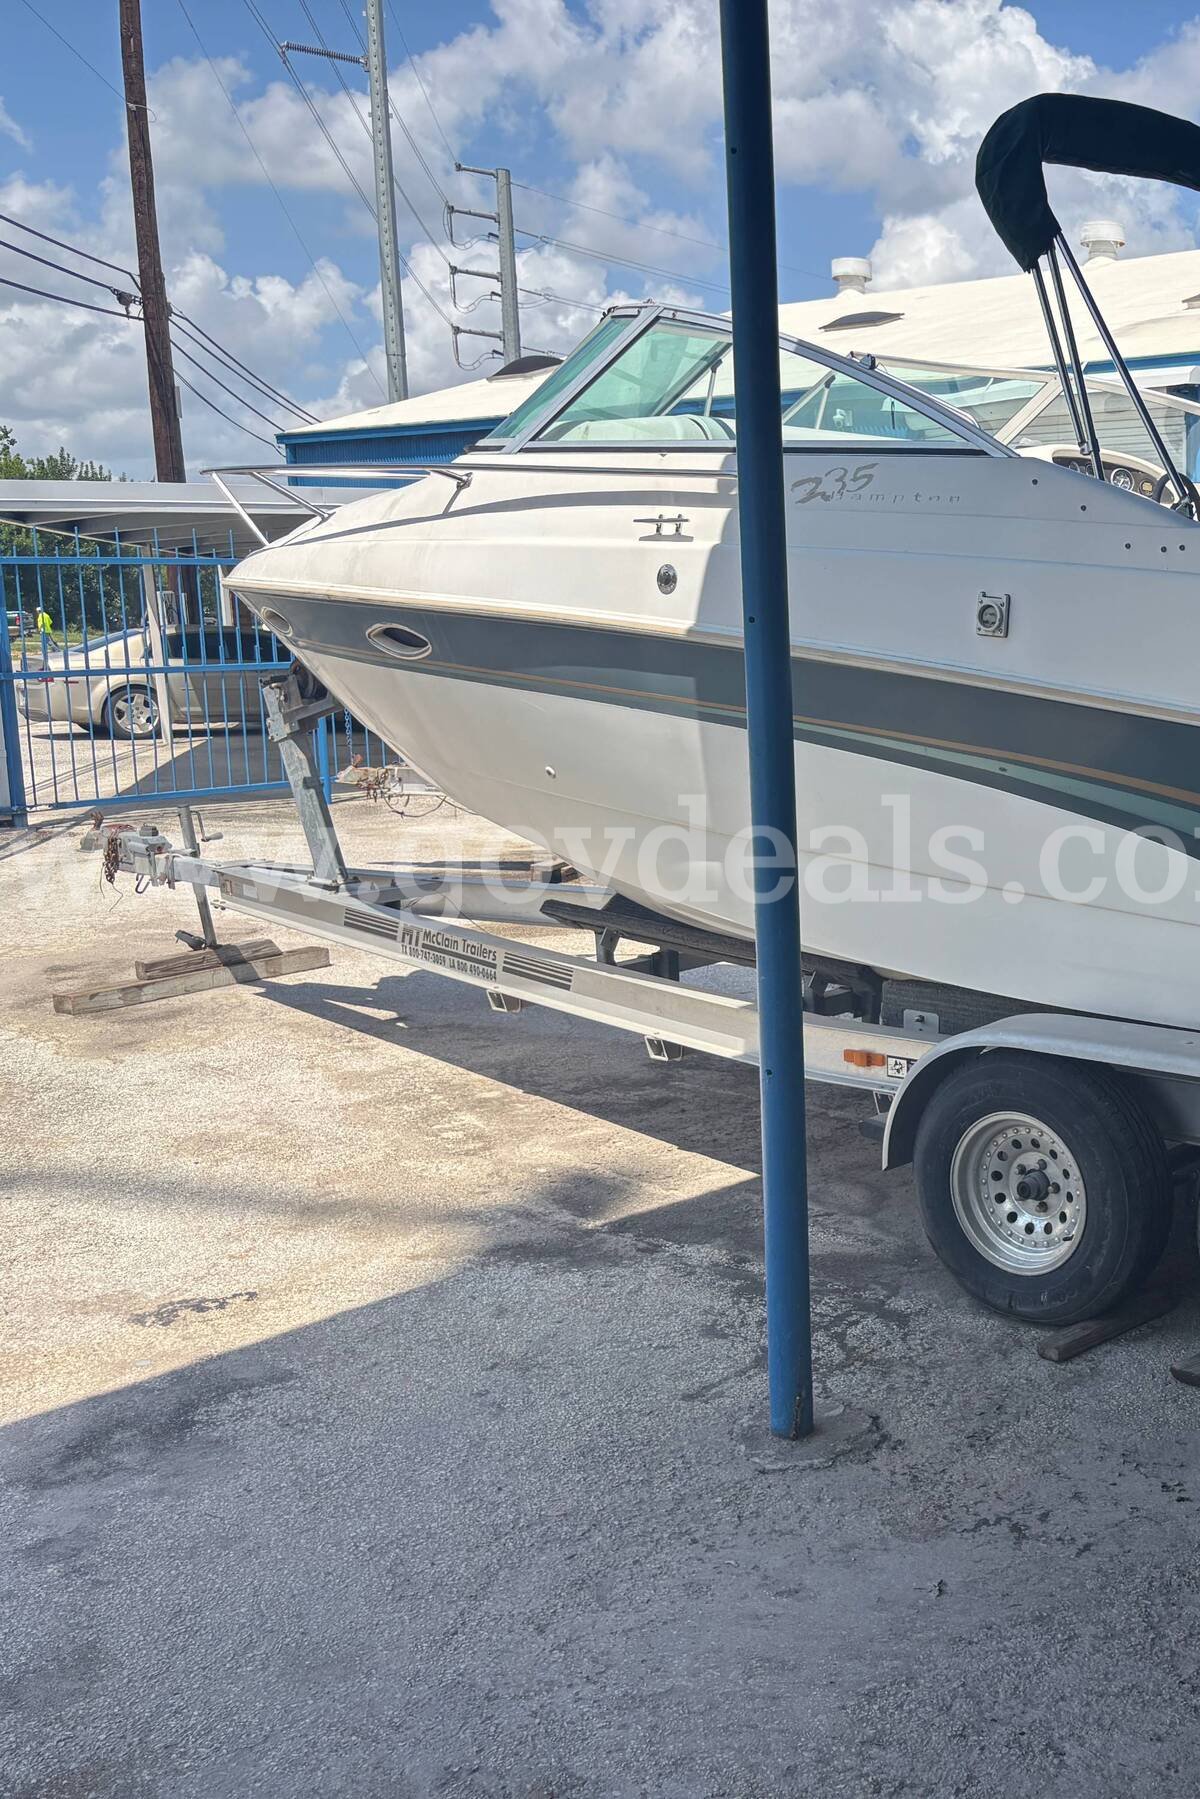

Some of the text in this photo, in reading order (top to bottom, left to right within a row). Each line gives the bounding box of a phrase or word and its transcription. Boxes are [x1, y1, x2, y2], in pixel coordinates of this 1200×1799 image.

[790, 462, 880, 504] 235
[423, 929, 497, 961] McClain Trailers
